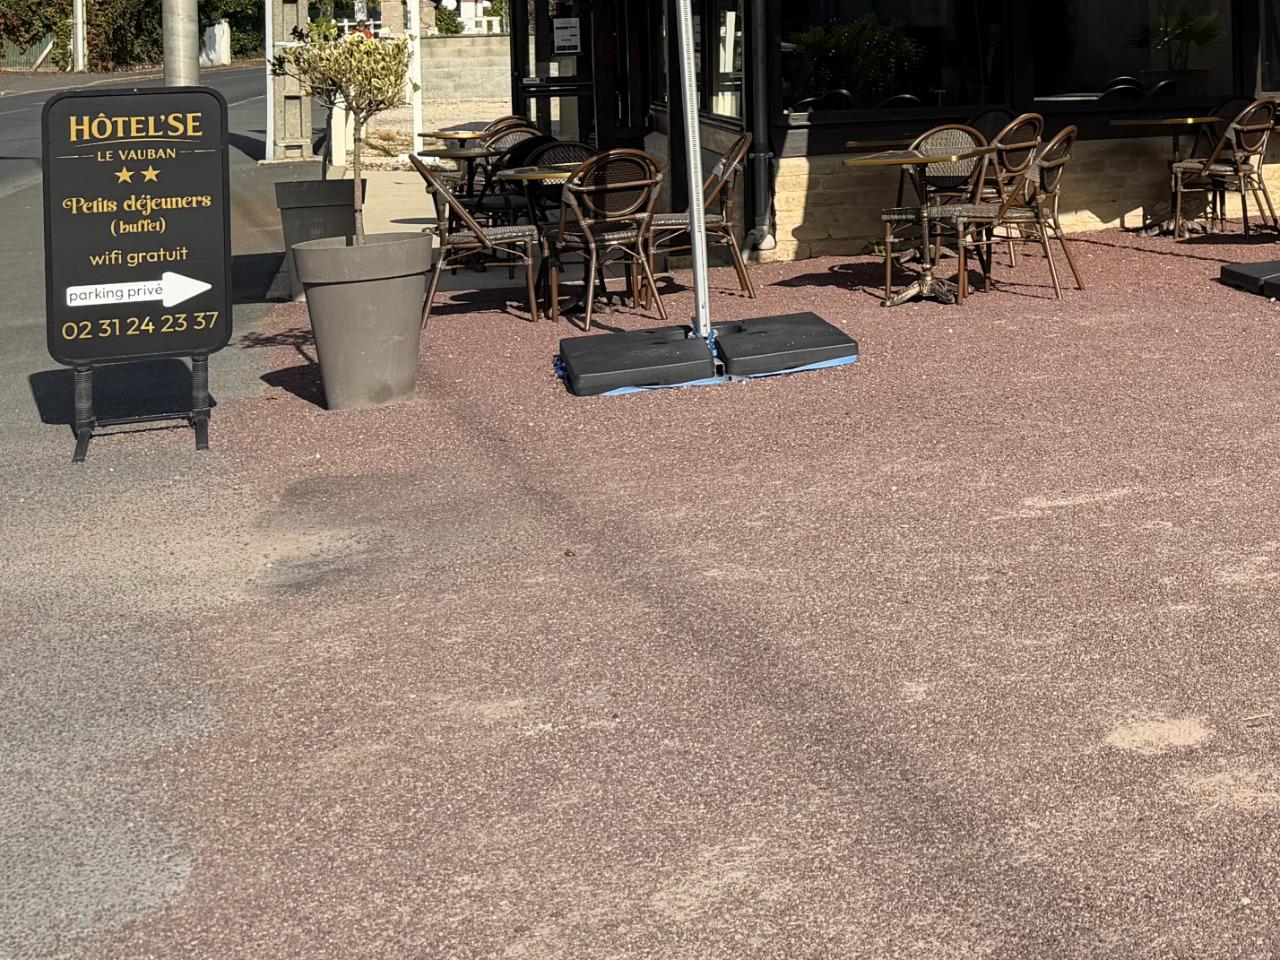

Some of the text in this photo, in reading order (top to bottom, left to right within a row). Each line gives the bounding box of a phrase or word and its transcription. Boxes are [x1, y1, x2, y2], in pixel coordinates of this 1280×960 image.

[69, 112, 203, 141] HÔTEL'SE
[97, 148, 176, 162] LE VAUBAN
[62, 193, 212, 216] Petits déjeuners
[89, 246, 188, 267] wifi gratuit
[69, 283, 163, 303] parking privé
[62, 311, 219, 340] 02 31 24 23 37
